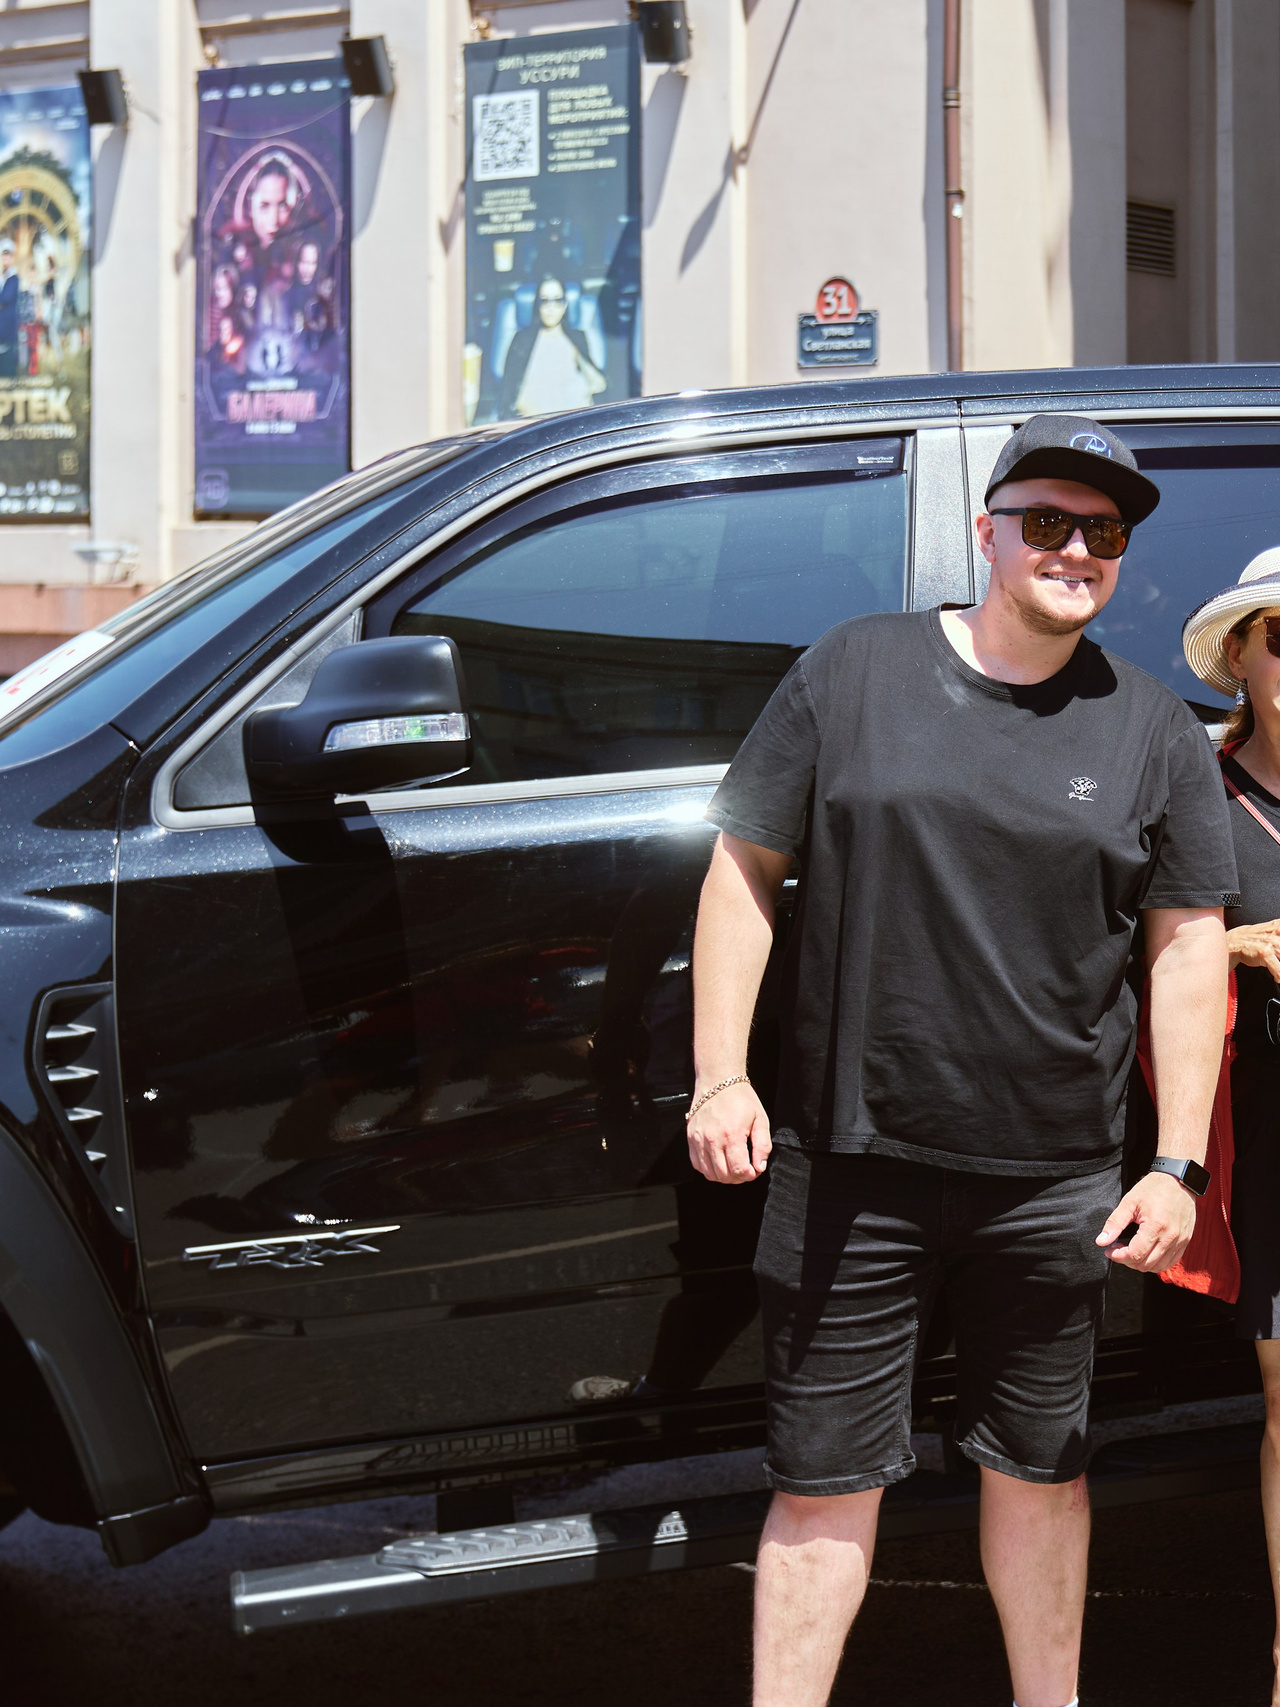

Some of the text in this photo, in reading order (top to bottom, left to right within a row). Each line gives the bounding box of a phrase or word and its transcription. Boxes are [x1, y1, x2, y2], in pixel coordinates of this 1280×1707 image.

[519, 65, 580, 84] УССУРИ
[823, 286, 852, 315] 31
[821, 327, 855, 340] улица
[803, 339, 871, 352] Светланская
